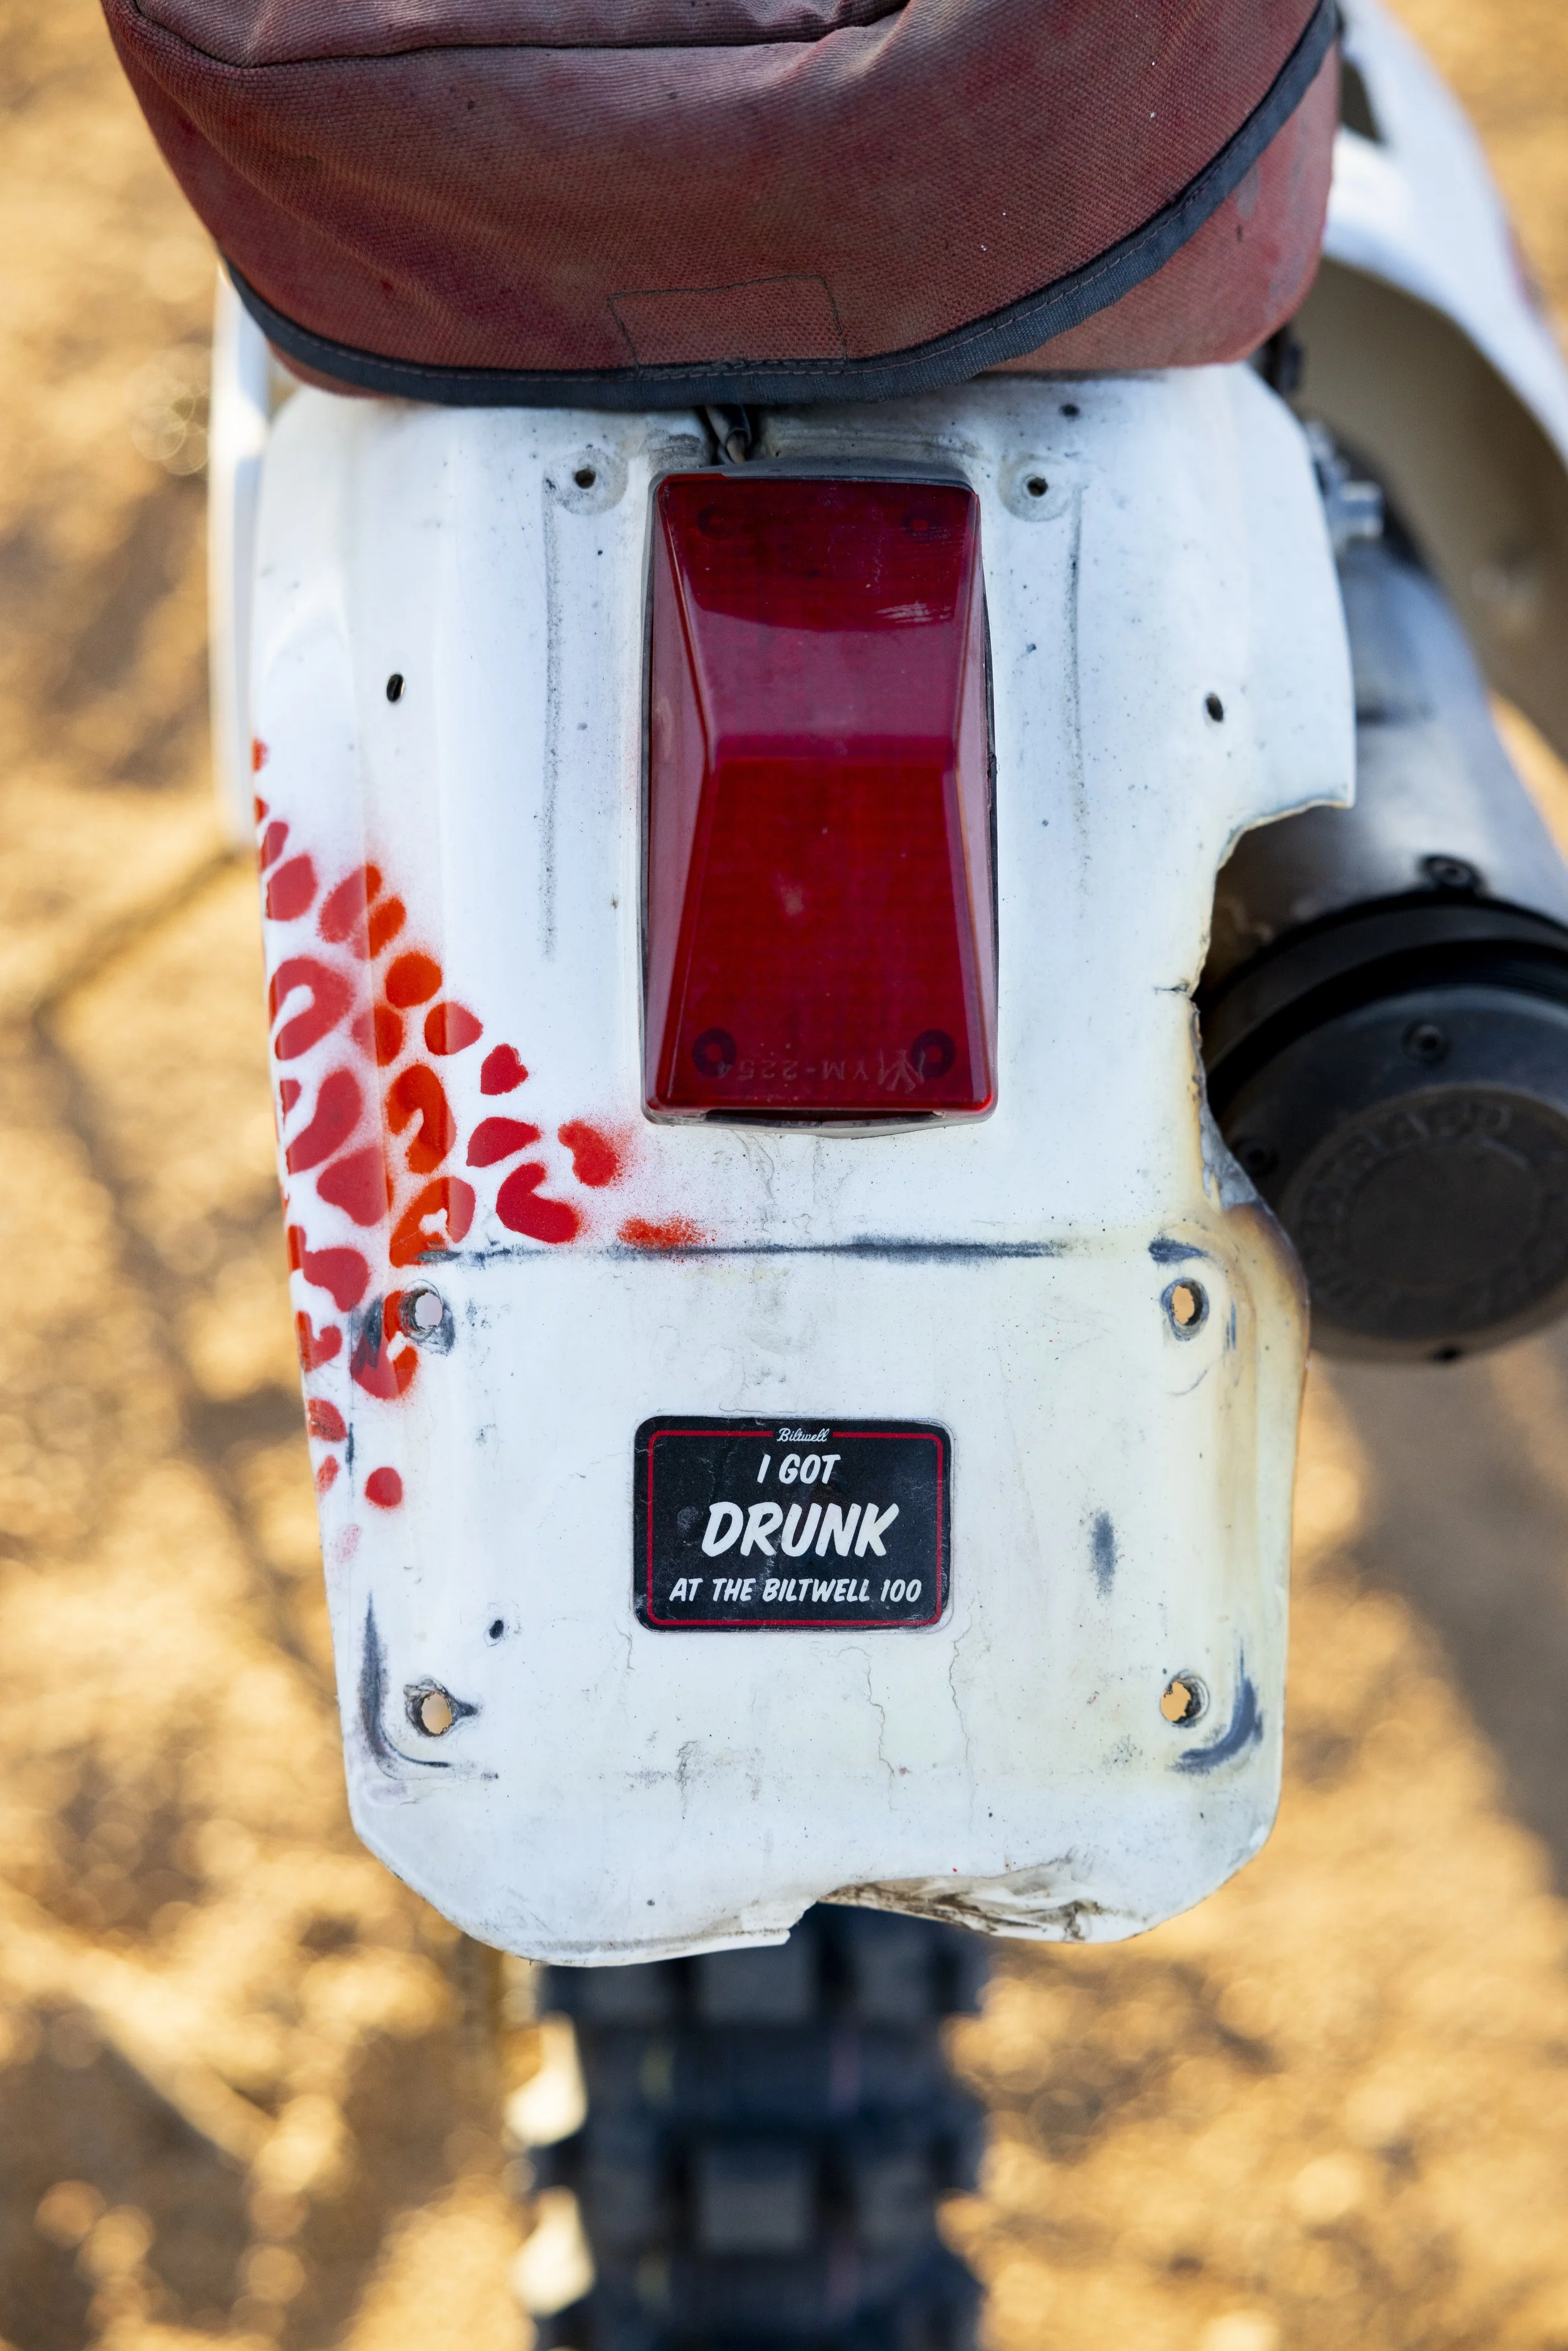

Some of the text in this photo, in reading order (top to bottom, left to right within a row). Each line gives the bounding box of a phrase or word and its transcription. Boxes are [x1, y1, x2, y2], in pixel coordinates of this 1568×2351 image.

[776, 1428, 830, 1442] Biltwell
[757, 1454, 841, 1484] I GOT
[702, 1502, 899, 1557] DRUNK
[669, 1578, 922, 1602] AT THE BILTWELL 100
